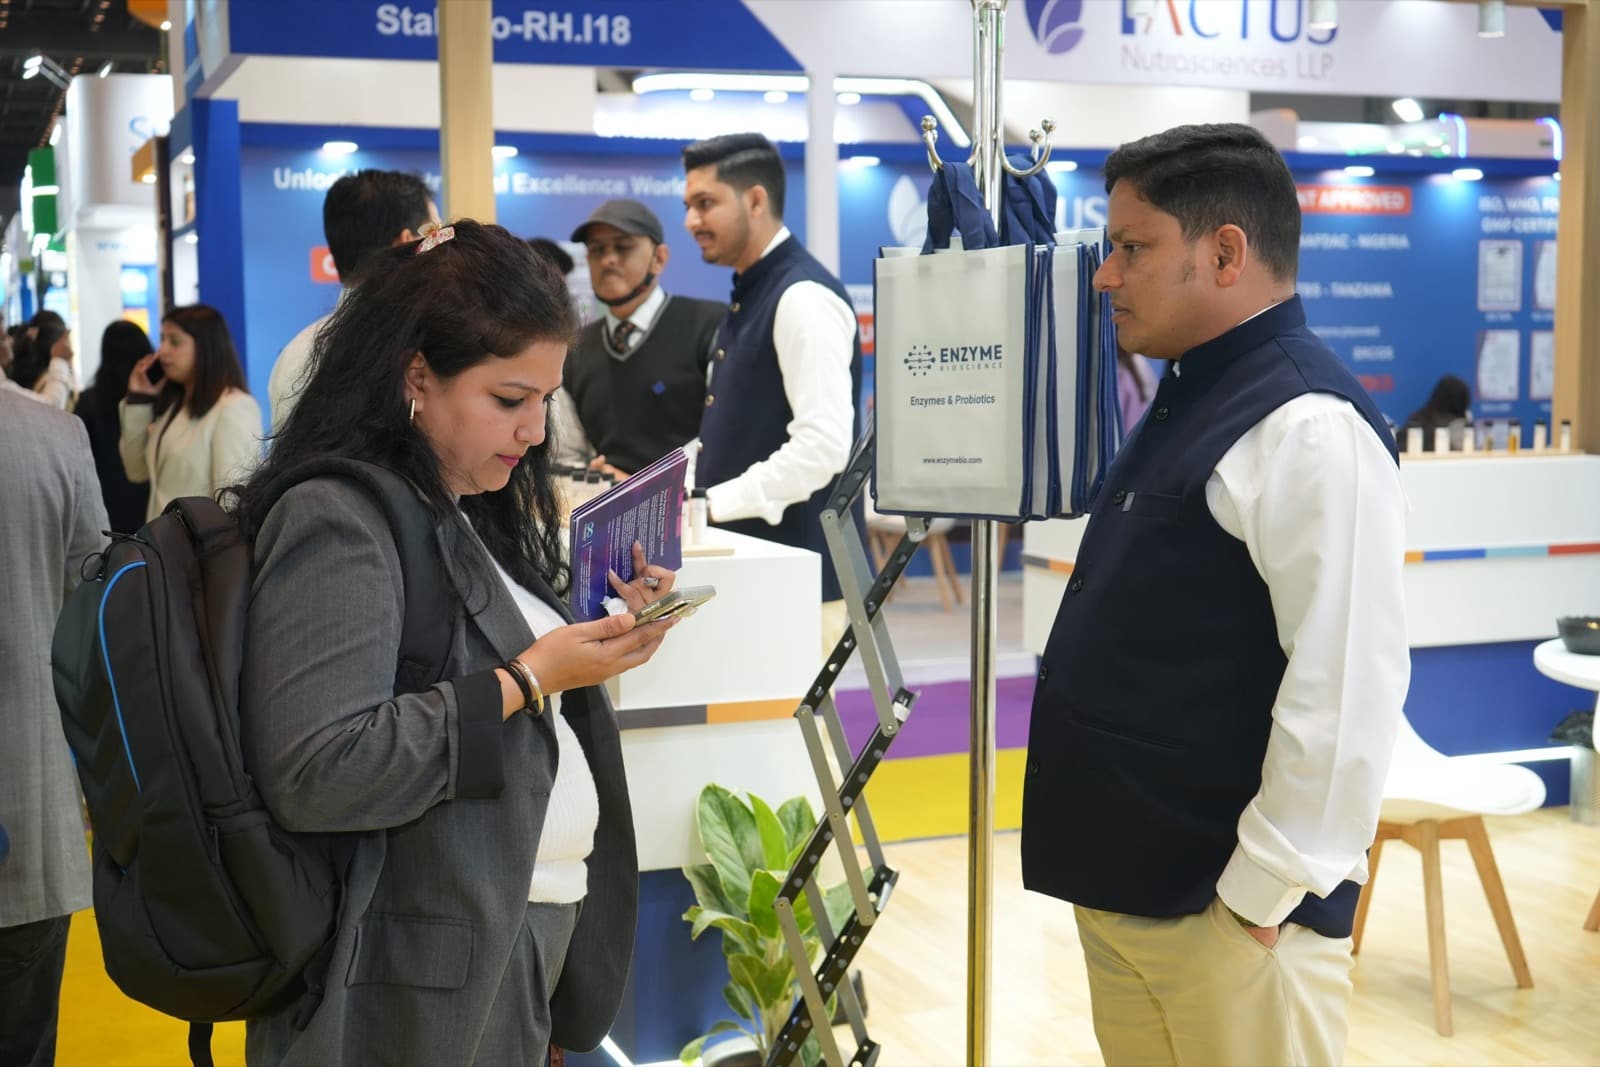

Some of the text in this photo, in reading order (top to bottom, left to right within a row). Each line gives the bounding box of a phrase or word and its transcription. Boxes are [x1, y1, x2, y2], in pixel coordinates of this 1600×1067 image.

[940, 344, 1002, 363] ENZYME
[940, 362, 1002, 371] BIOSCIENCE
[910, 393, 995, 408] Enzymes & Probiotics
